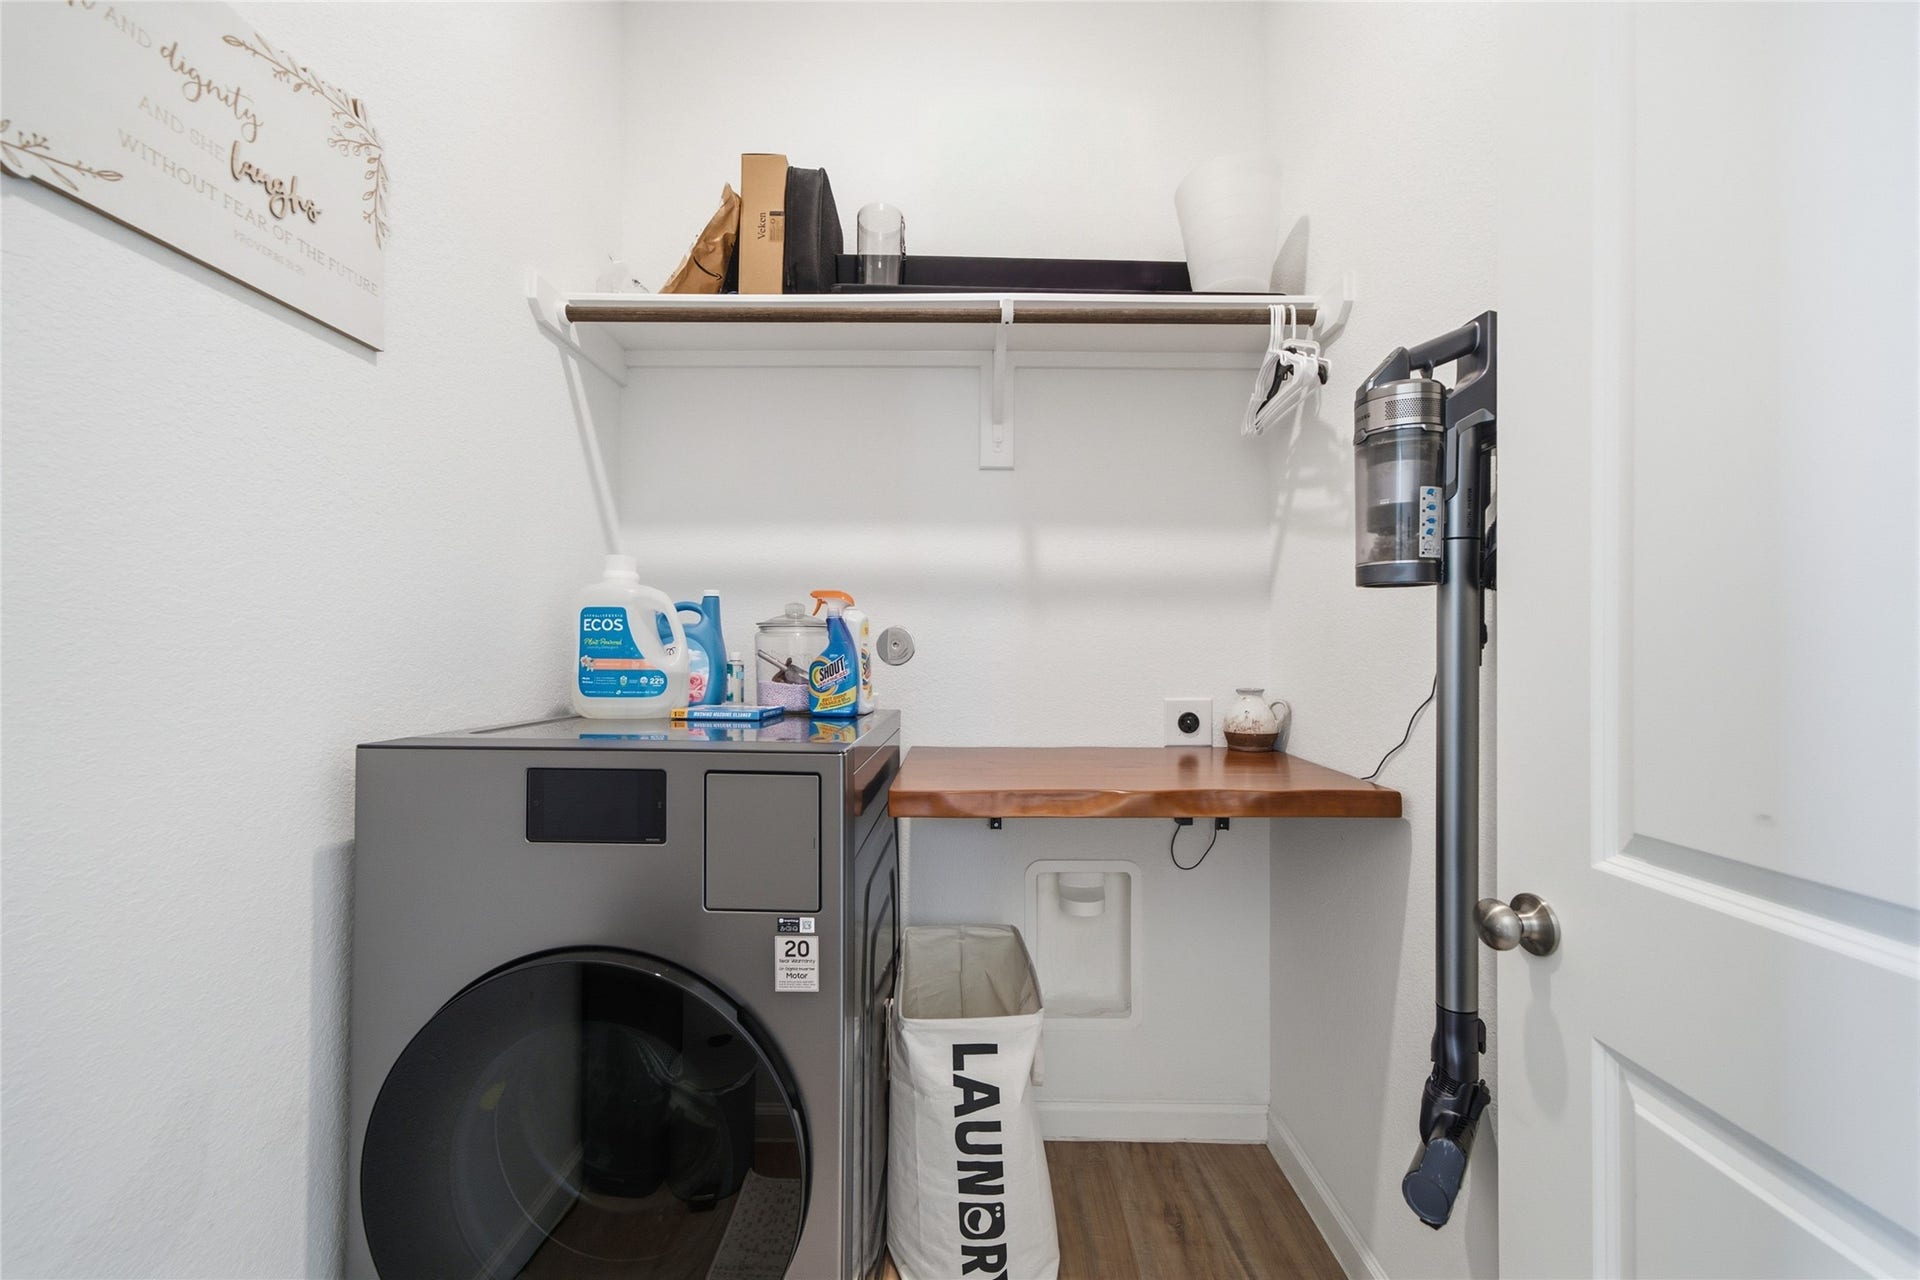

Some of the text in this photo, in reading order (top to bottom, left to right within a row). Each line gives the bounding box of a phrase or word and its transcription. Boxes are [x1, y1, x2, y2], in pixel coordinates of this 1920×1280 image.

[104, 7, 264, 143] AND dignity
[137, 96, 322, 224] AND SHE laughs
[117, 128, 218, 201] WITHOUT
[222, 193, 268, 233] FEAR
[272, 225, 294, 245] OF
[297, 238, 326, 269] THE
[328, 257, 379, 297] FUTURE
[757, 212, 767, 240] Veken
[583, 619, 624, 631] ECOS
[649, 677, 664, 685] 225
[819, 655, 845, 682] SHOUT
[785, 940, 809, 957] 20
[952, 1043, 1009, 1280] LAUNDR
